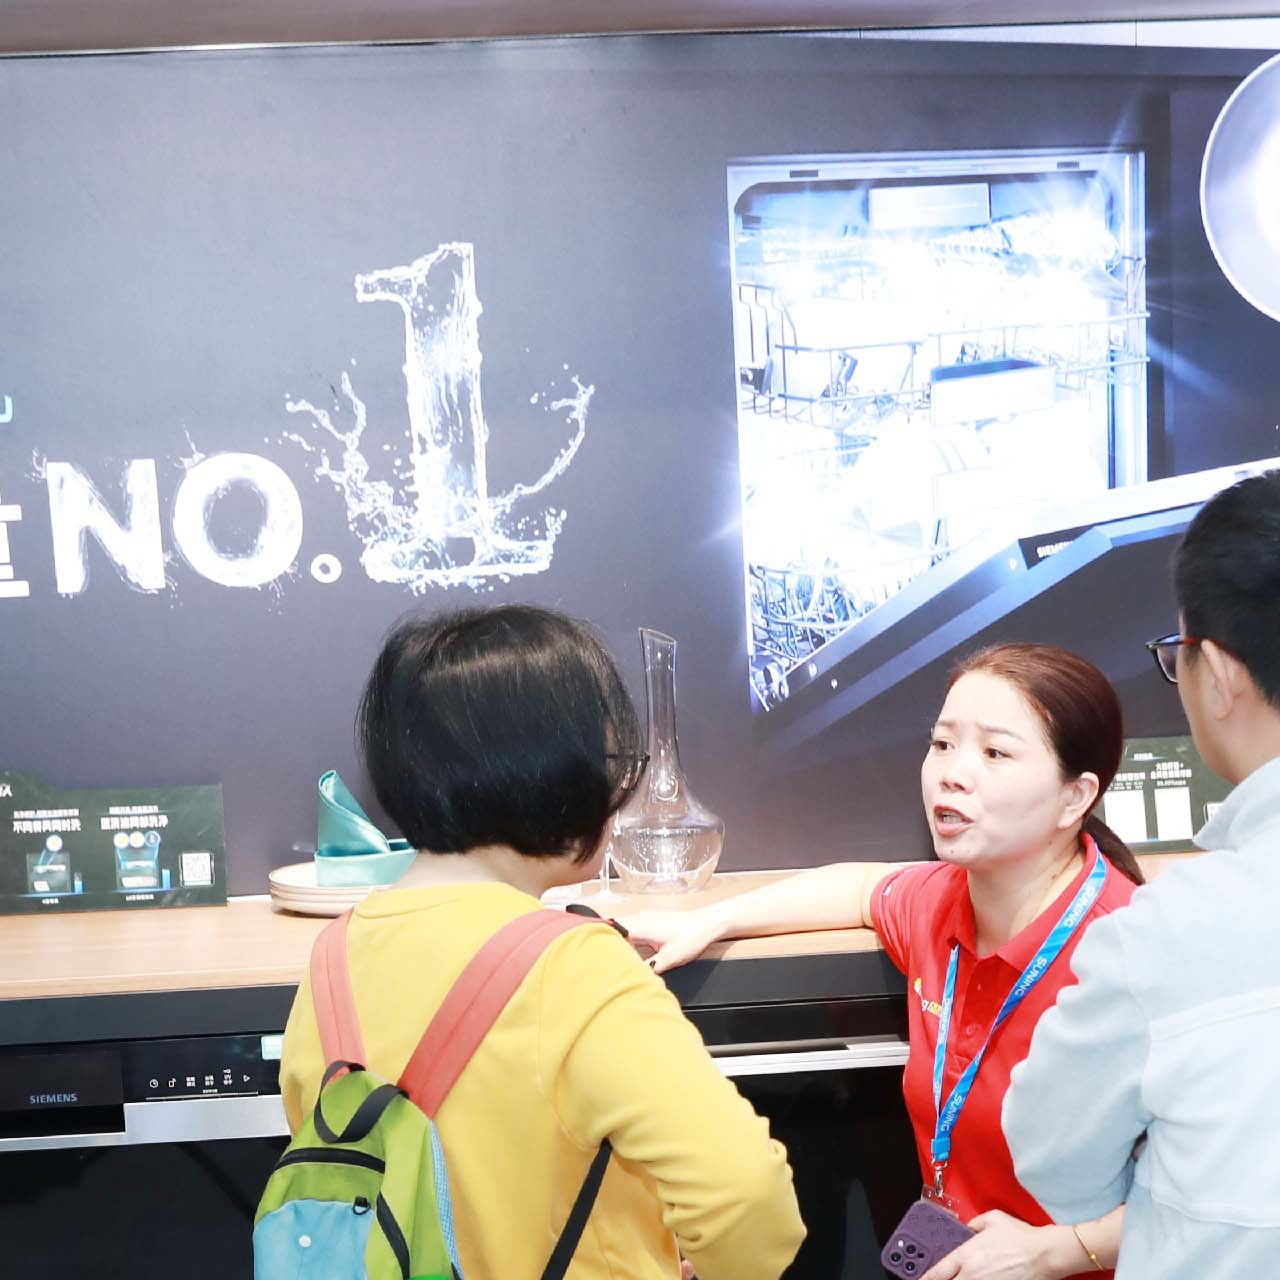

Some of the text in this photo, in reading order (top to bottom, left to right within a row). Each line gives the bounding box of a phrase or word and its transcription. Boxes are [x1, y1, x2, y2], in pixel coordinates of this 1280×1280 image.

[1036, 541, 1073, 558] SIEM
[1014, 956, 1048, 997] SUNING
[29, 1091, 78, 1104] SIEMENS
[940, 1093, 963, 1132] SUNING
